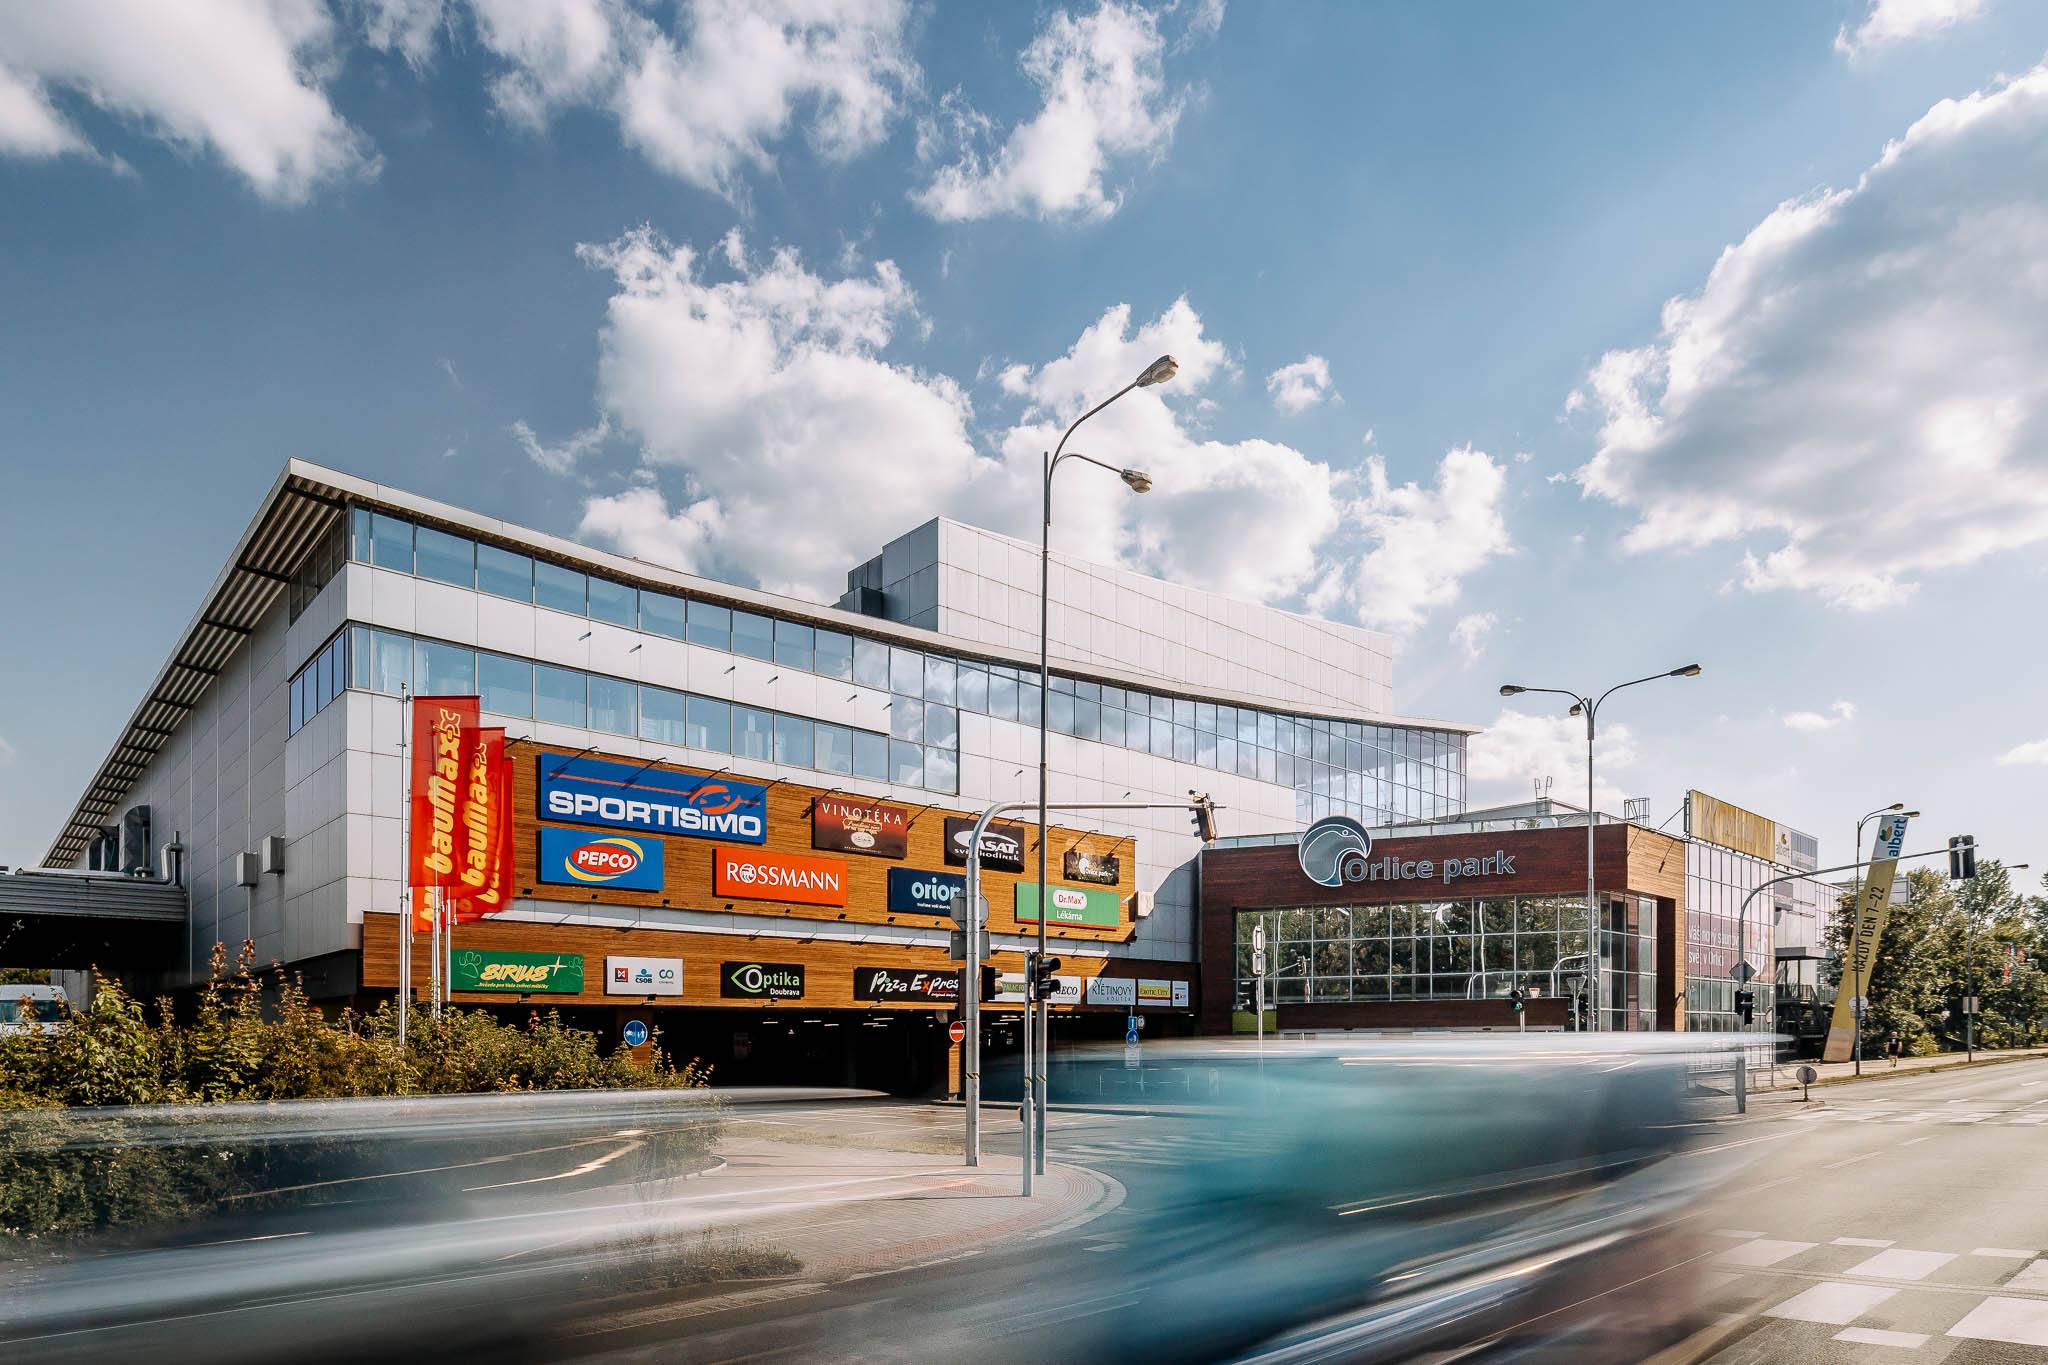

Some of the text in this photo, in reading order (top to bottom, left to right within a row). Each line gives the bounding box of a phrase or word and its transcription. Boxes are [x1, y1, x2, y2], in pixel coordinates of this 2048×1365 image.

[549, 790, 761, 837] SPORTISIMO
[822, 802, 903, 825] VINOTÉKA
[1887, 818, 1907, 858] albert
[577, 850, 633, 868] PEPCO
[1345, 850, 1516, 884] Orlice park
[726, 862, 839, 891] ROSSMANN
[1056, 910, 1083, 921] Lékárna
[1860, 917, 1876, 937] DEN
[480, 963, 550, 982] SIRIUS
[745, 968, 800, 989] Optika
[870, 970, 908, 993] Pizza
[770, 987, 800, 996] Doubrava
